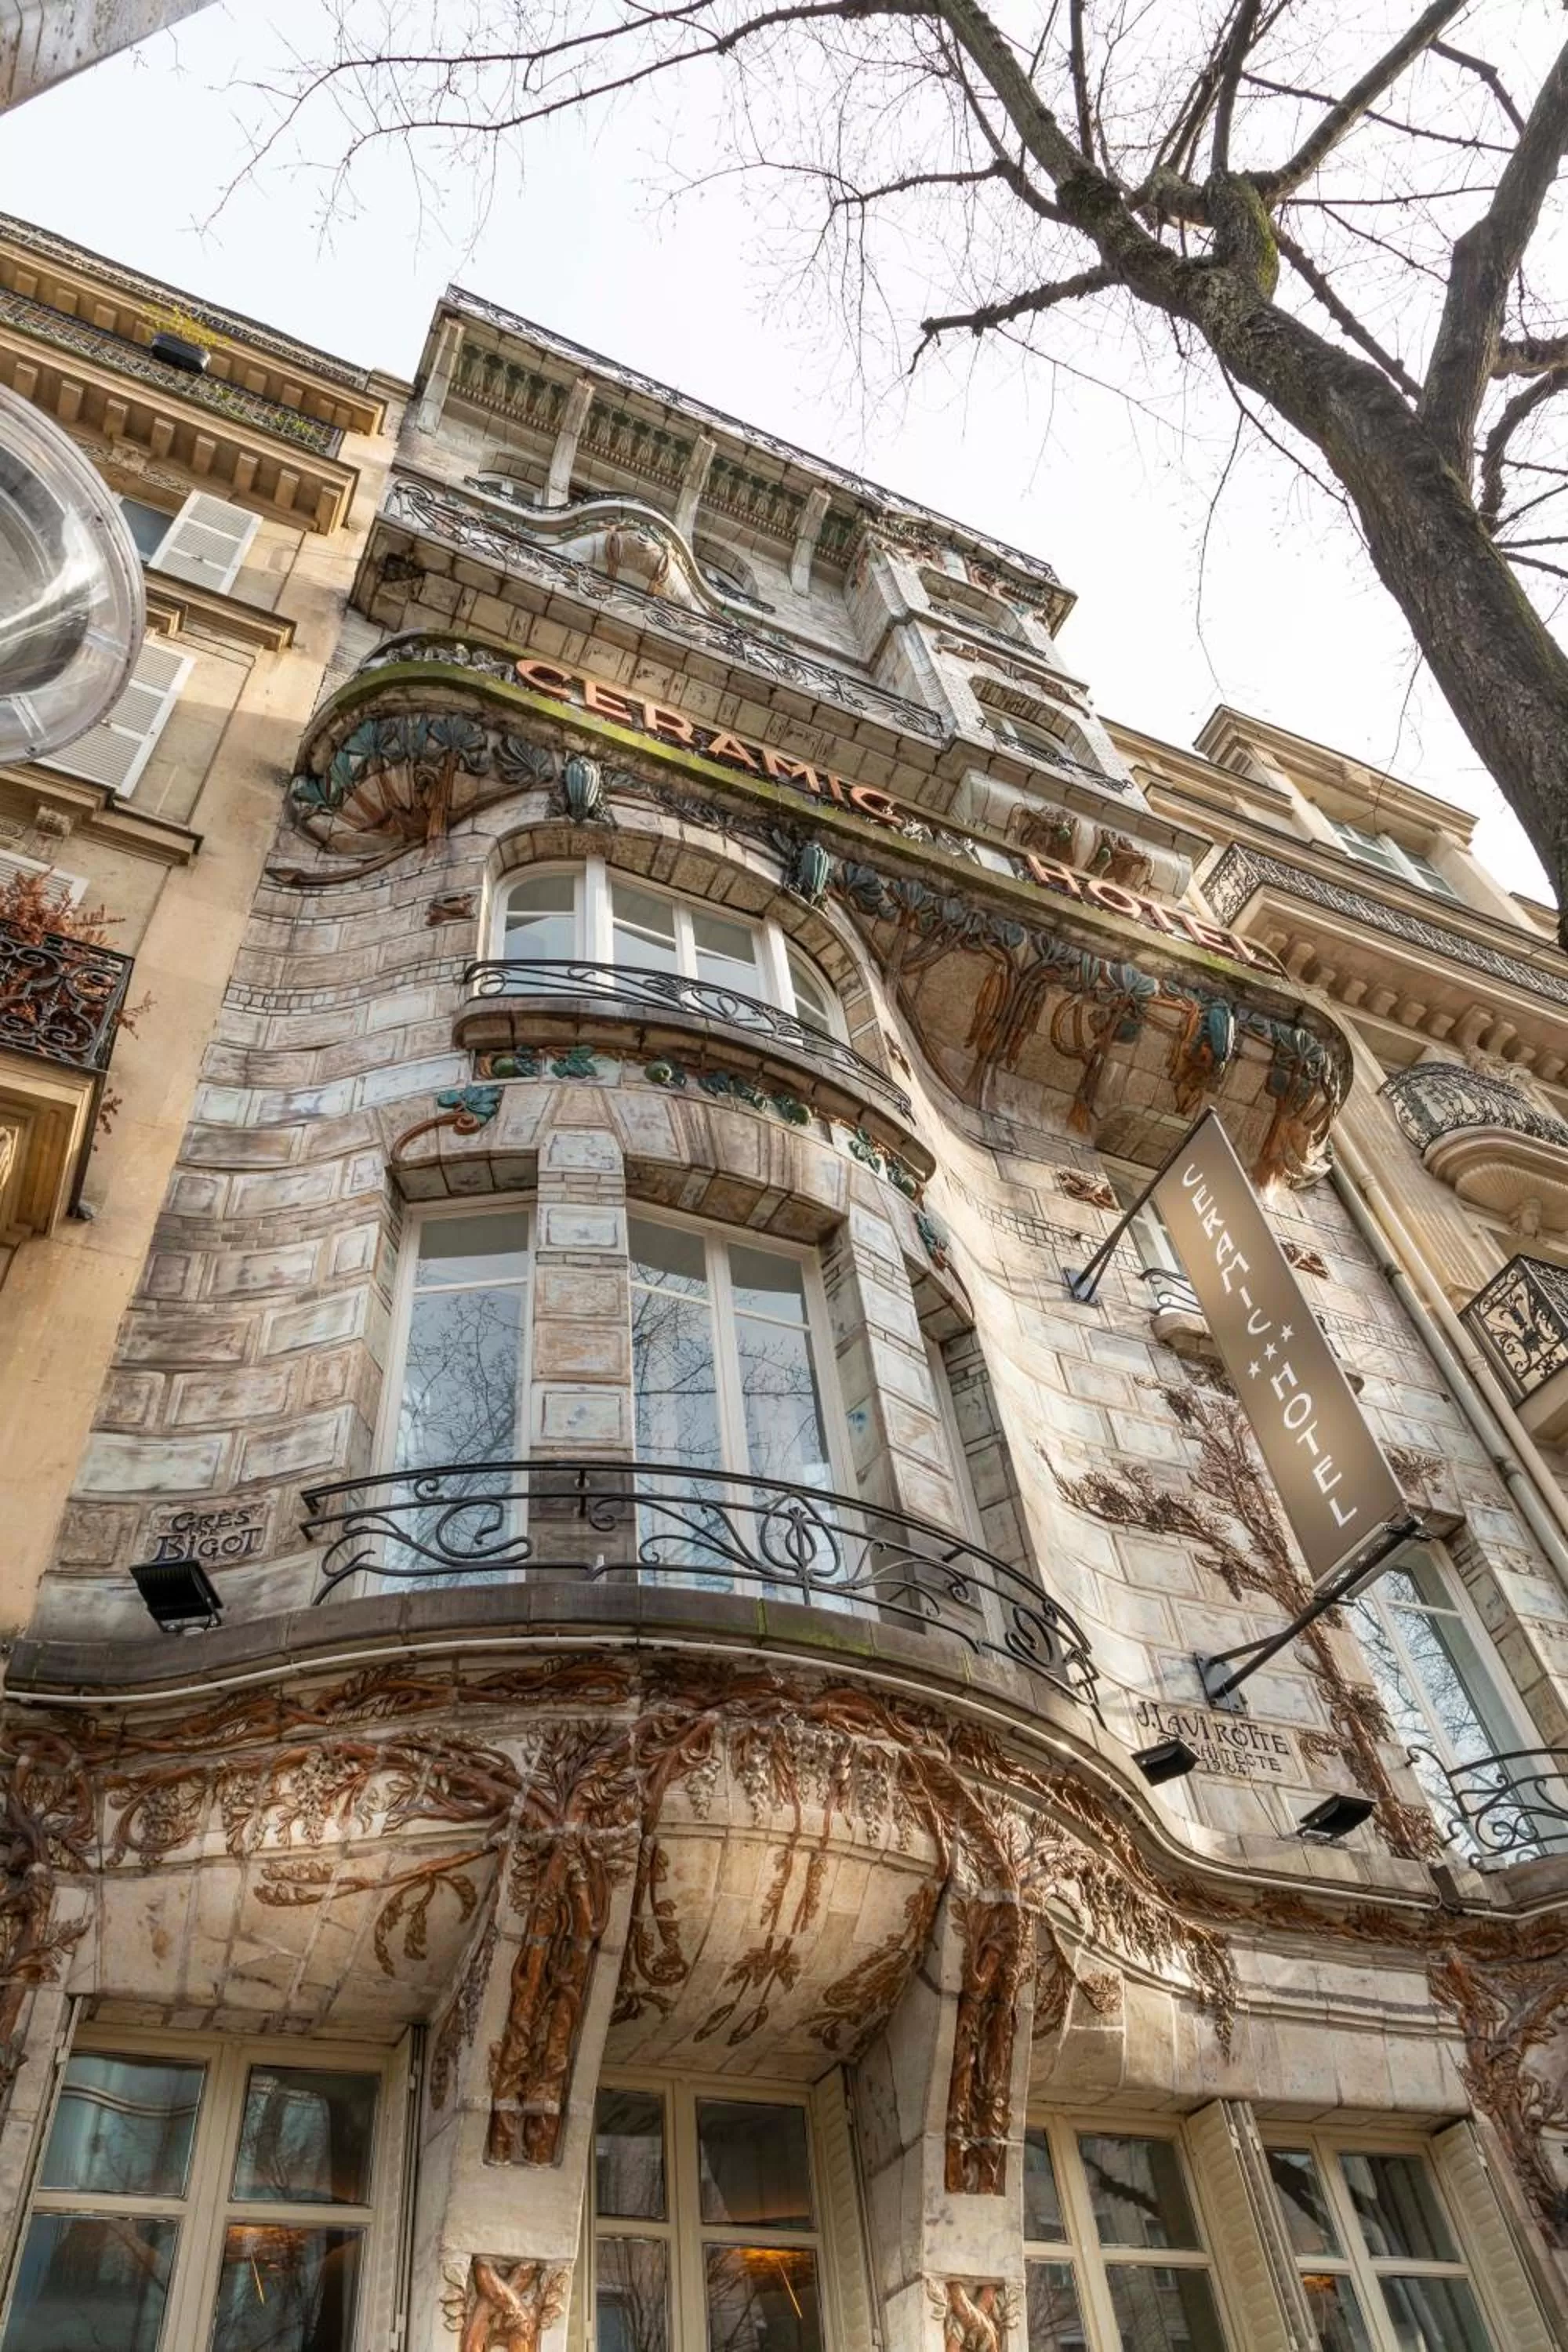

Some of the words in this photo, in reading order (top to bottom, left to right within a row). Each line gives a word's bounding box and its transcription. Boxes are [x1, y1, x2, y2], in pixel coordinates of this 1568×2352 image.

[516, 659, 902, 826] CERAMIC
[1025, 853, 1283, 977] HOTEL
[1182, 1163, 1272, 1334] CERAMIC
[1270, 1360, 1358, 1528] HOTEL
